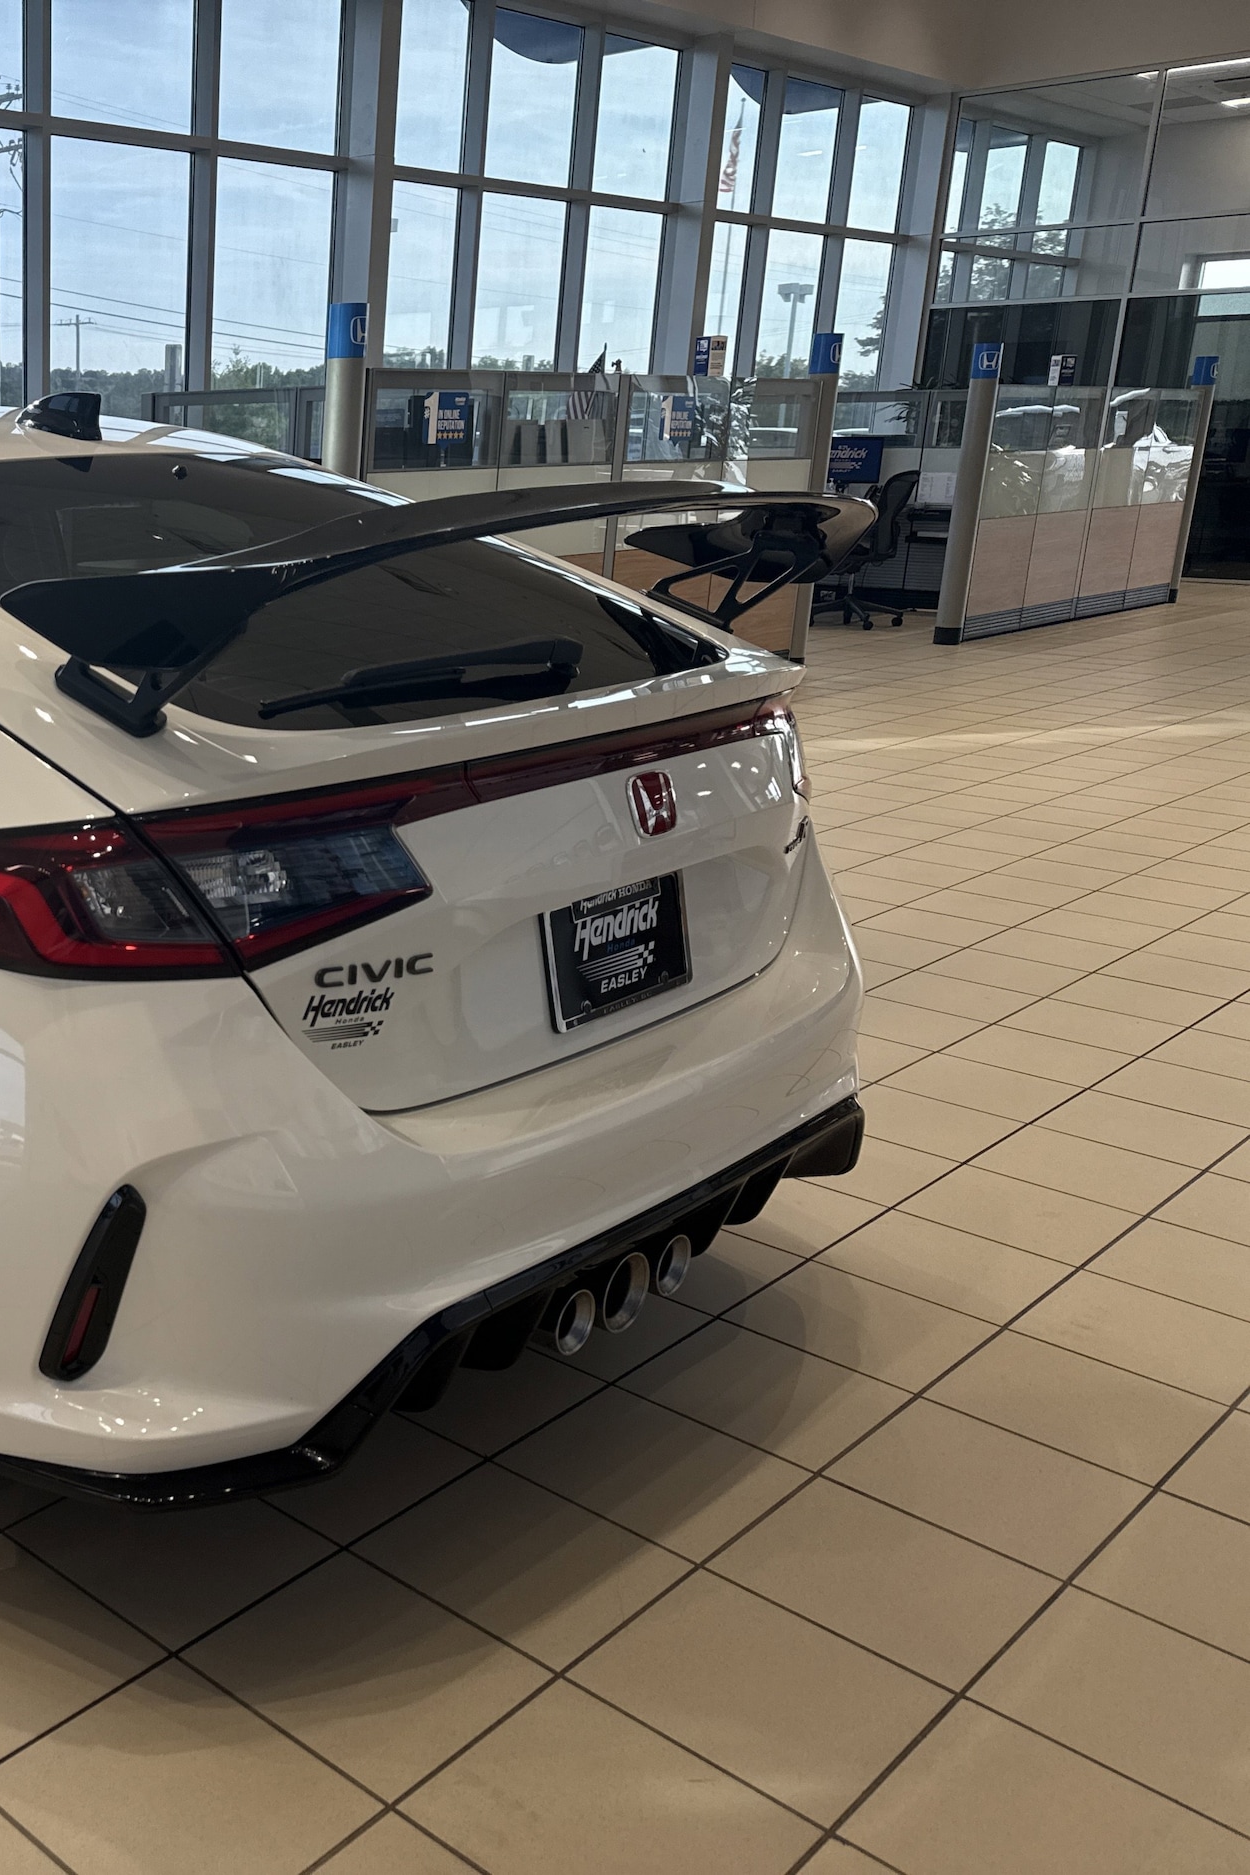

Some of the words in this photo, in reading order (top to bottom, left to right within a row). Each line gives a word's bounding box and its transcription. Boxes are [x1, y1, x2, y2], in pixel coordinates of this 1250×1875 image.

[438, 420, 465, 430] REPUTATION
[617, 880, 653, 899] HONDA
[574, 896, 660, 962] Hendrick
[606, 938, 636, 954] Honda
[313, 952, 435, 989] CIVIC
[600, 966, 648, 994] EASLEY
[301, 986, 396, 1028] Hendrick
[334, 1016, 365, 1026] Honda
[330, 1039, 365, 1051] EASLEY
